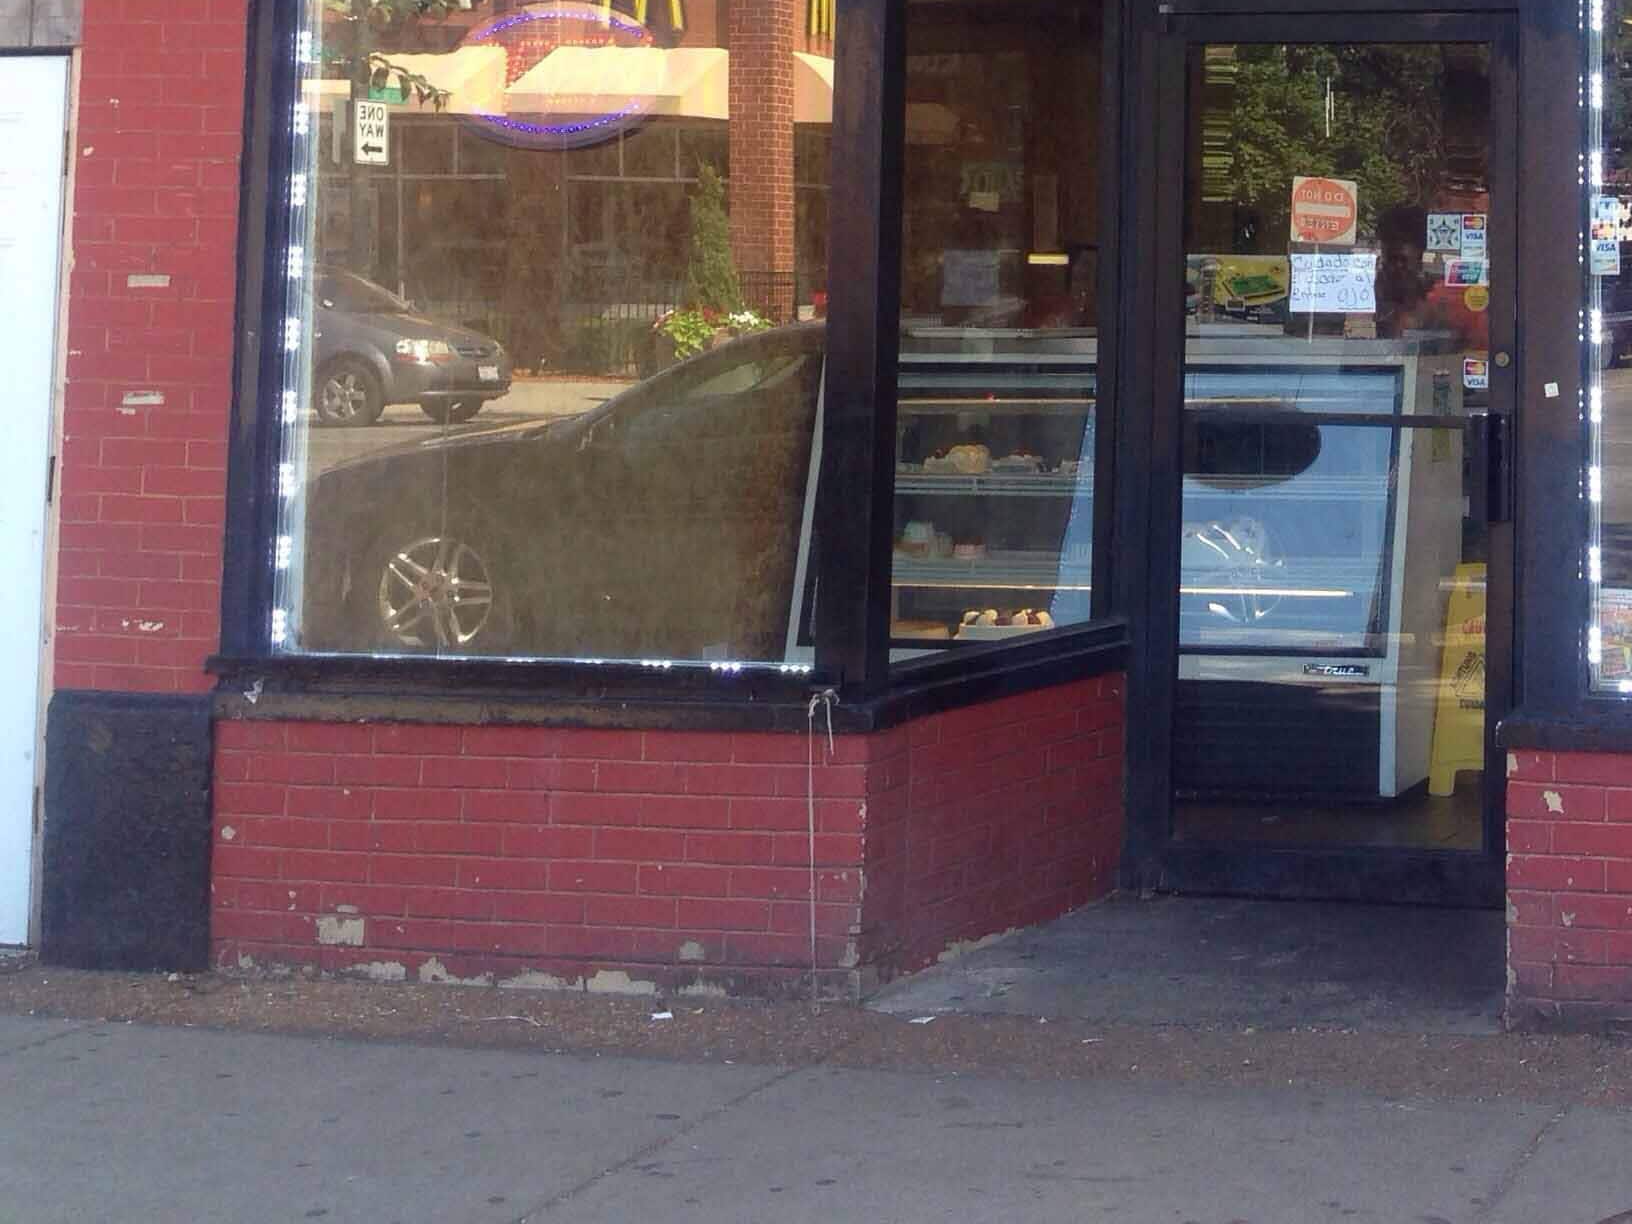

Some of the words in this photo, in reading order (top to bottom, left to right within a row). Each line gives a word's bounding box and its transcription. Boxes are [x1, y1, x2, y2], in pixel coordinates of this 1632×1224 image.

[1465, 232, 1484, 241] VISA
[1596, 242, 1616, 252] VISA
[1467, 377, 1486, 386] VISA
